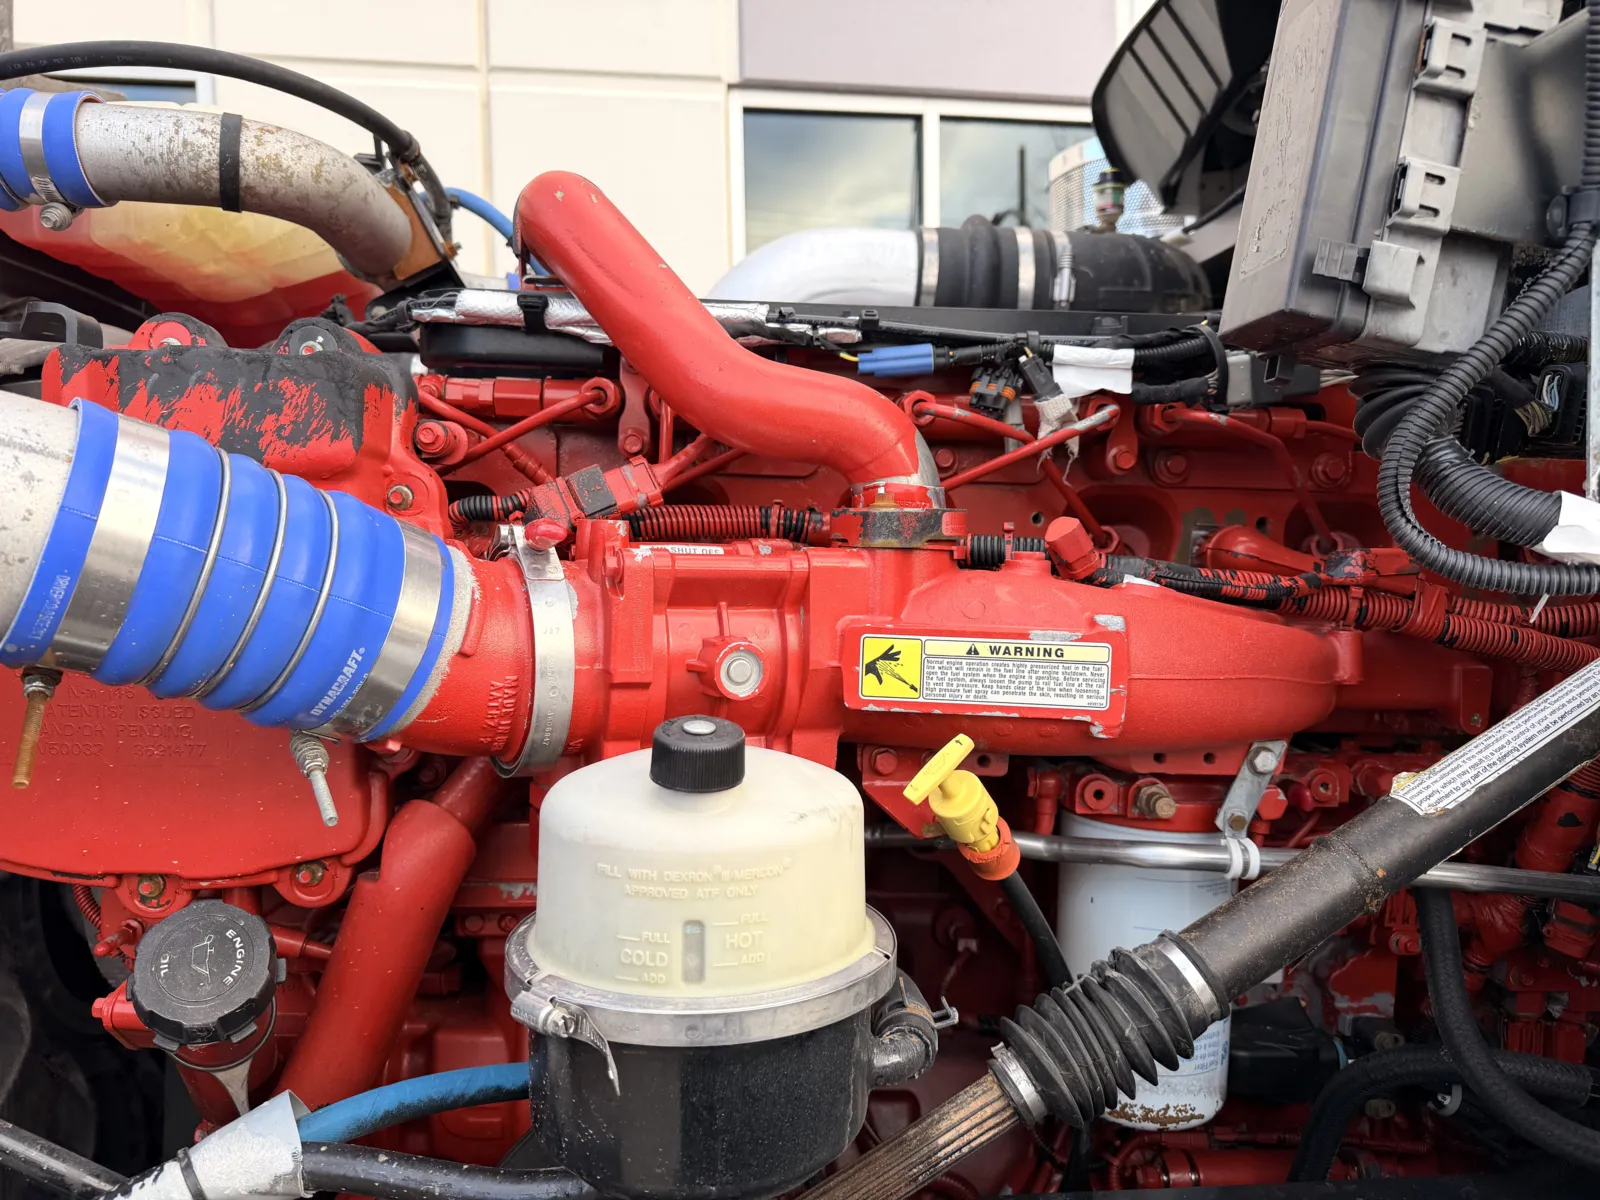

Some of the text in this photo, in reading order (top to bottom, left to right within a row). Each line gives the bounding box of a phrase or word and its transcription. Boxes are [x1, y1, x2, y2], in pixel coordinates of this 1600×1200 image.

[990, 645, 1065, 658] WARNING
[502, 675, 519, 716] MADE
[45, 704, 195, 719] ATENT(S) ISSUED
[116, 723, 192, 737] PENDING
[1470, 772, 1483, 780] part
[1517, 734, 1539, 748] system
[1536, 724, 1551, 734] must
[1557, 702, 1586, 721] performed
[1417, 787, 1442, 805] properly,
[1440, 777, 1457, 788] which
[1468, 759, 1484, 769] result
[1511, 727, 1531, 740] control
[1536, 716, 1549, 725] your
[597, 862, 621, 878] FILL
[628, 868, 657, 882] WITH
[624, 885, 758, 899] APPROVED ATF ONLY
[740, 913, 771, 924] FULL
[642, 931, 671, 944] FULL
[725, 930, 764, 950] HOT
[160, 953, 169, 977] OIL
[223, 929, 245, 986] ENGINE
[620, 948, 668, 967] COLD
[741, 951, 765, 964] ADD
[642, 973, 667, 984] ADD
